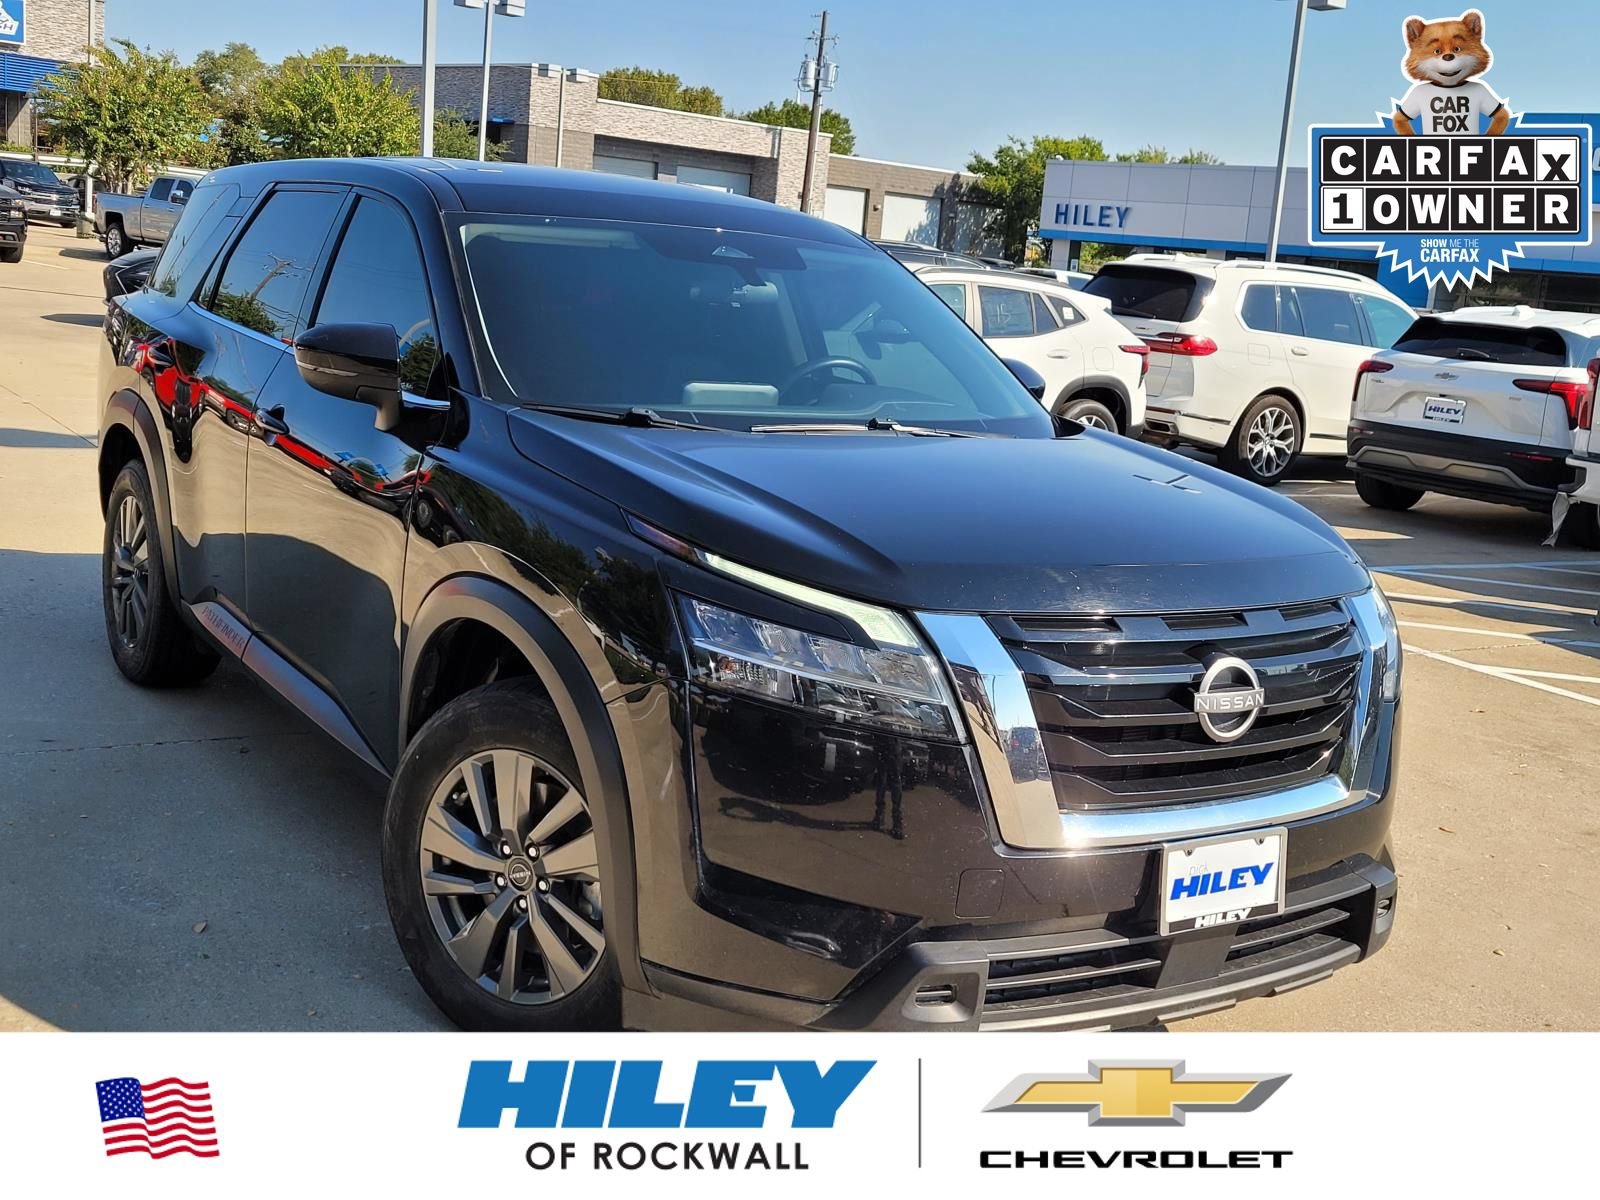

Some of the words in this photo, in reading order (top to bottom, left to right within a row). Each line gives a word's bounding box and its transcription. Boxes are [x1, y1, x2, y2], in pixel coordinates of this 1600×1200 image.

[1055, 203, 1130, 228] HILEY
[1428, 405, 1461, 415] HILEY
[1196, 692, 1264, 711] NISSAN
[1170, 861, 1274, 901] HILEY
[1195, 907, 1252, 929] HILEY
